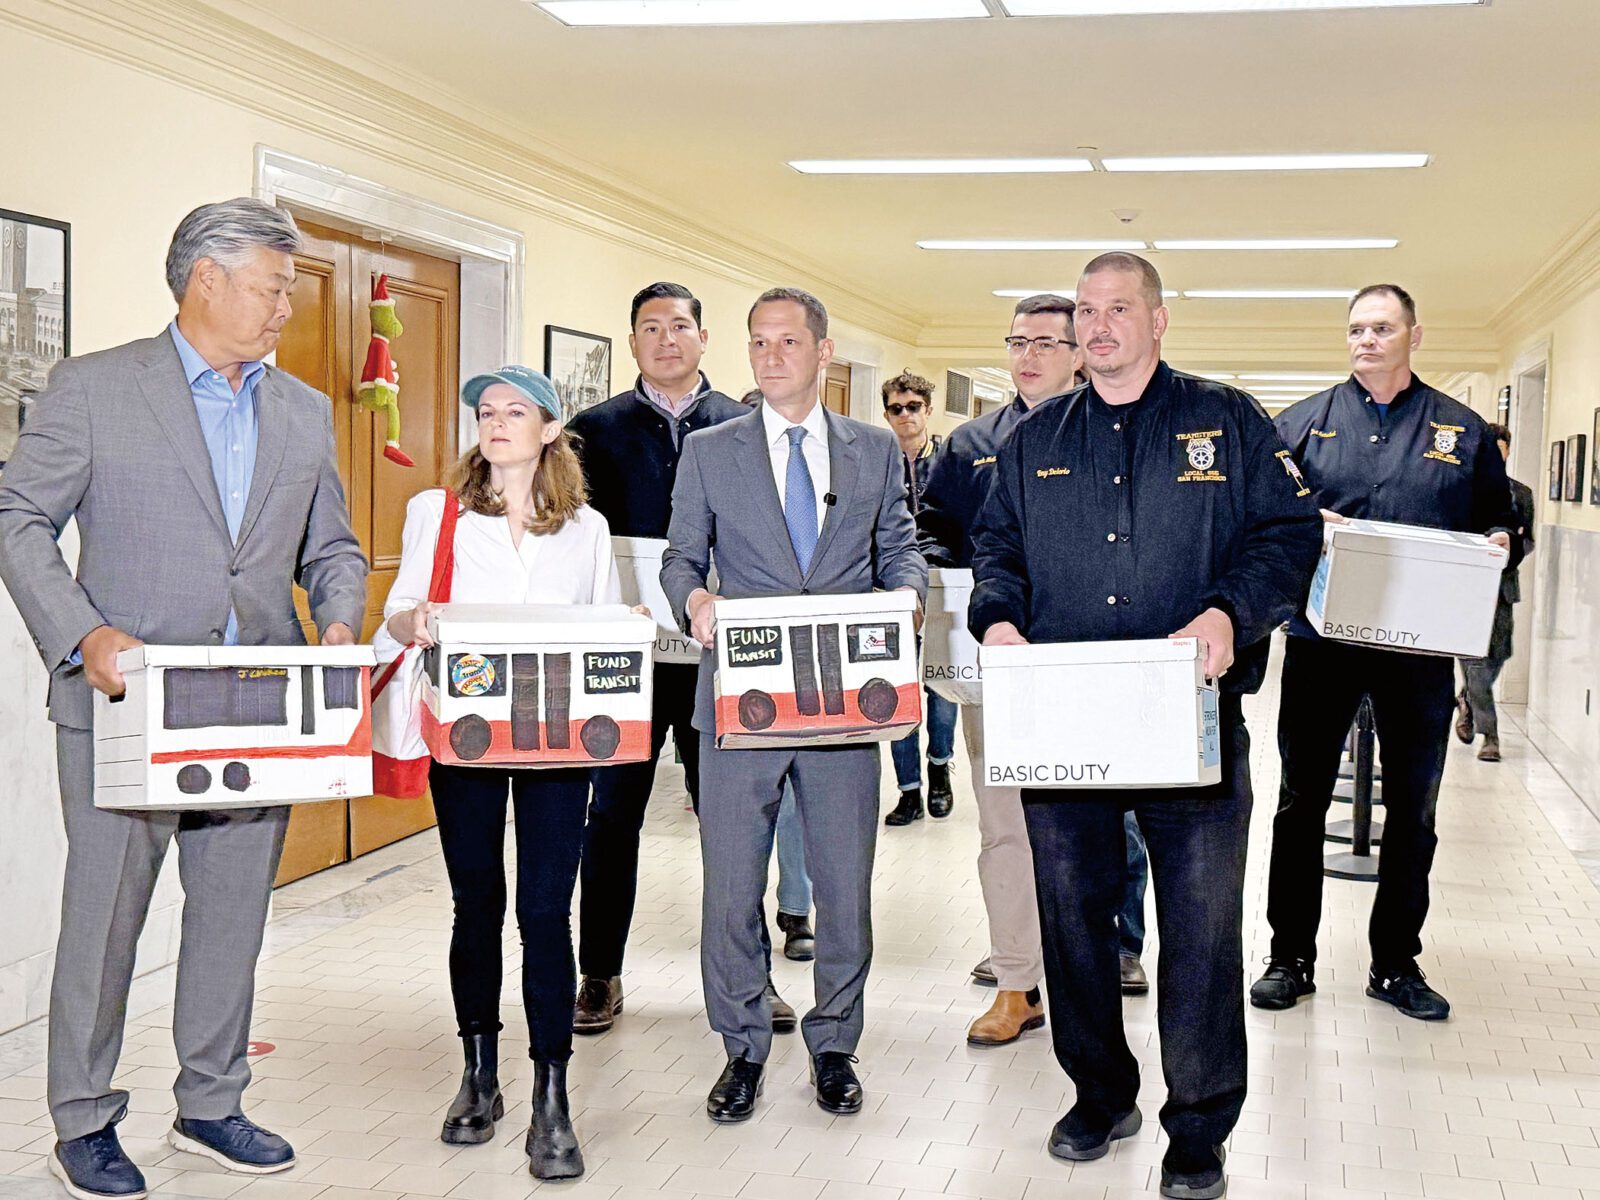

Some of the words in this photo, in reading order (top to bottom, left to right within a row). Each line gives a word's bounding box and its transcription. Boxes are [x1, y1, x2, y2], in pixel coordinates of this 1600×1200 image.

[1176, 430, 1222, 440] TEAMSTERS
[730, 628, 778, 645] FUND
[1323, 622, 1373, 639] BASIC
[1375, 629, 1420, 646] DUTY
[588, 655, 631, 669] FUND
[925, 665, 973, 679] BASIC
[586, 674, 640, 689] TRANSIT
[990, 765, 1049, 782] BASIC
[1055, 764, 1110, 781] DUTY
